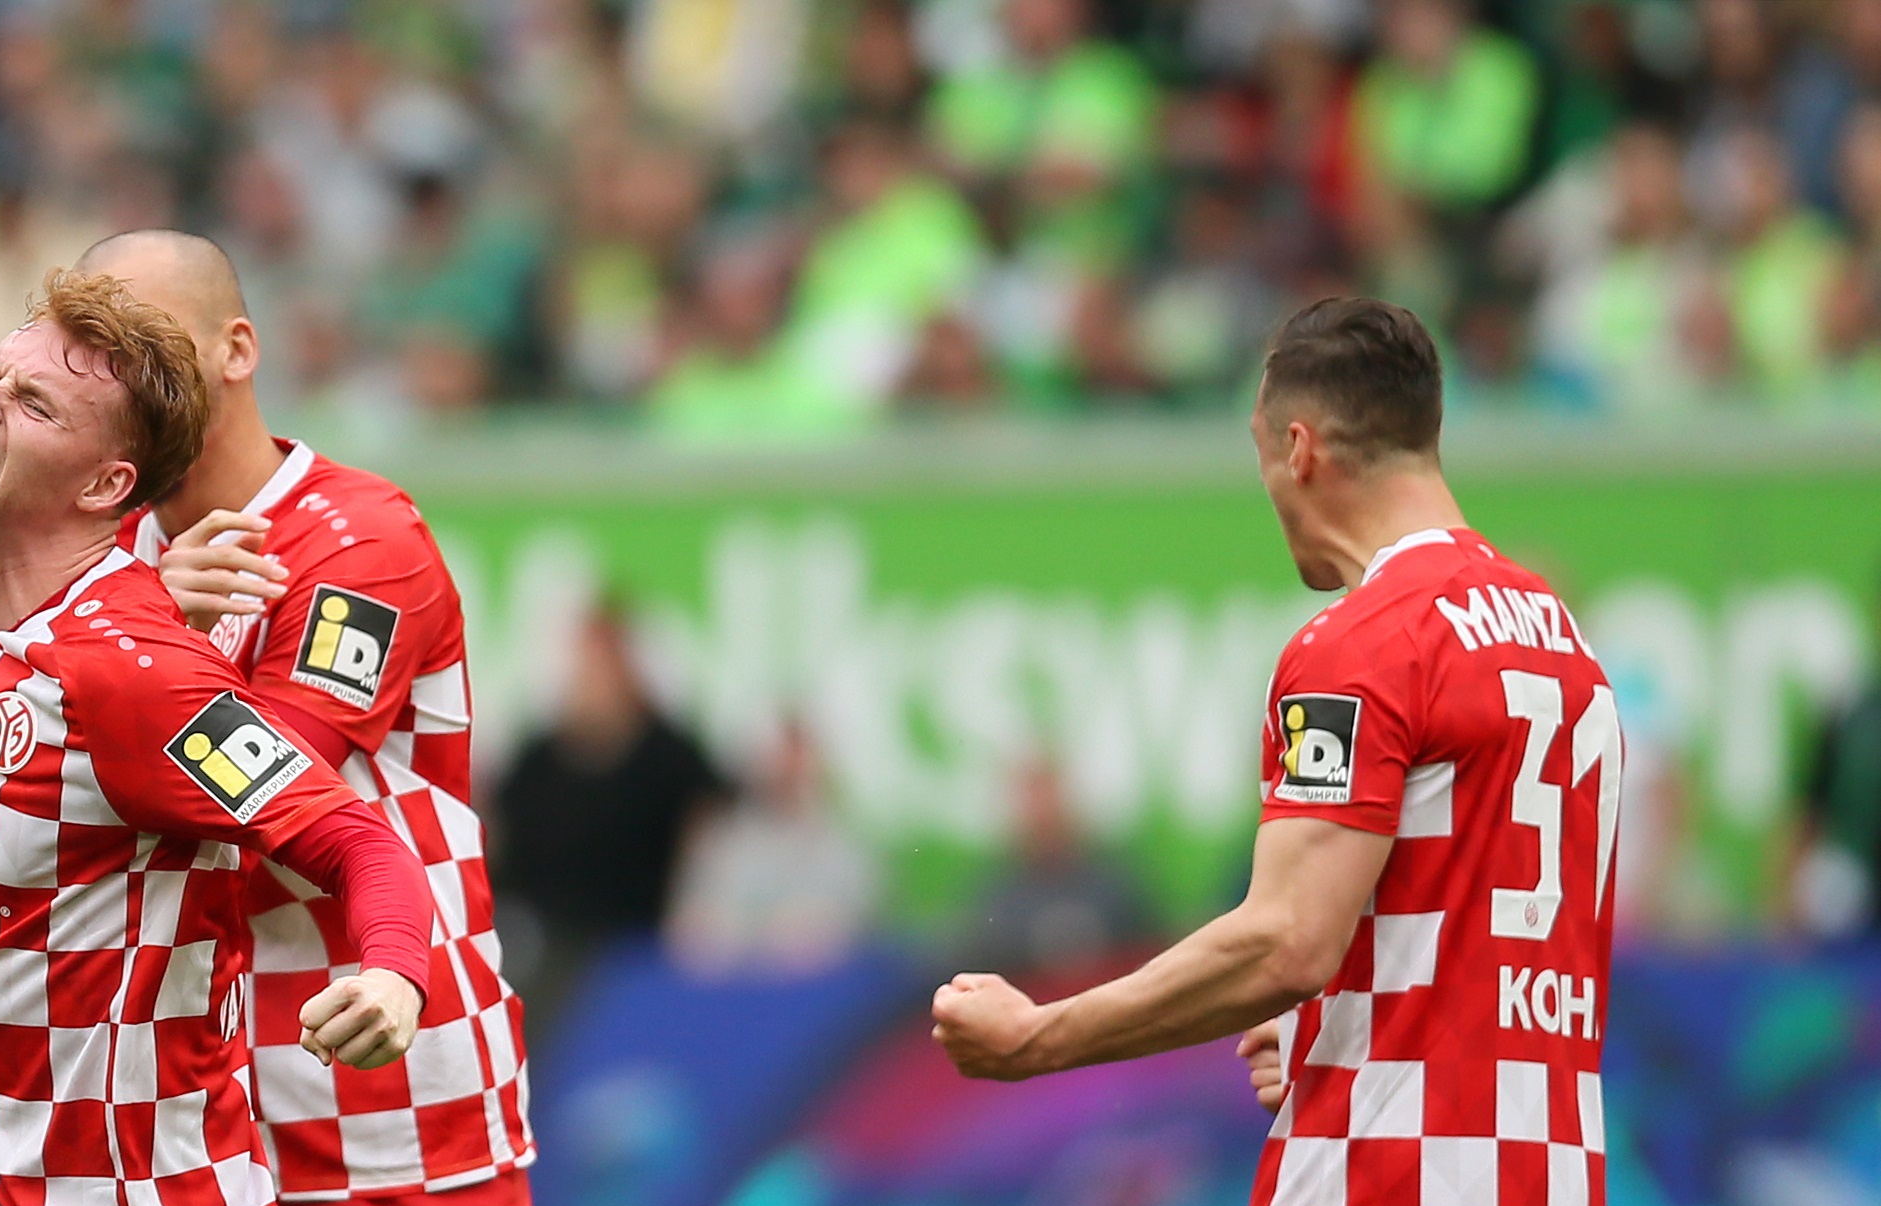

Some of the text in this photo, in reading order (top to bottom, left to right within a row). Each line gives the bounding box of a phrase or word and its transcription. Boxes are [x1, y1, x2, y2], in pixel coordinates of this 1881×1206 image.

[1435, 584, 1575, 655] MAINZ
[237, 757, 310, 822] WÄRMEPUMPEN
[1490, 669, 1623, 941] 31
[1499, 965, 1600, 1041] KOH
